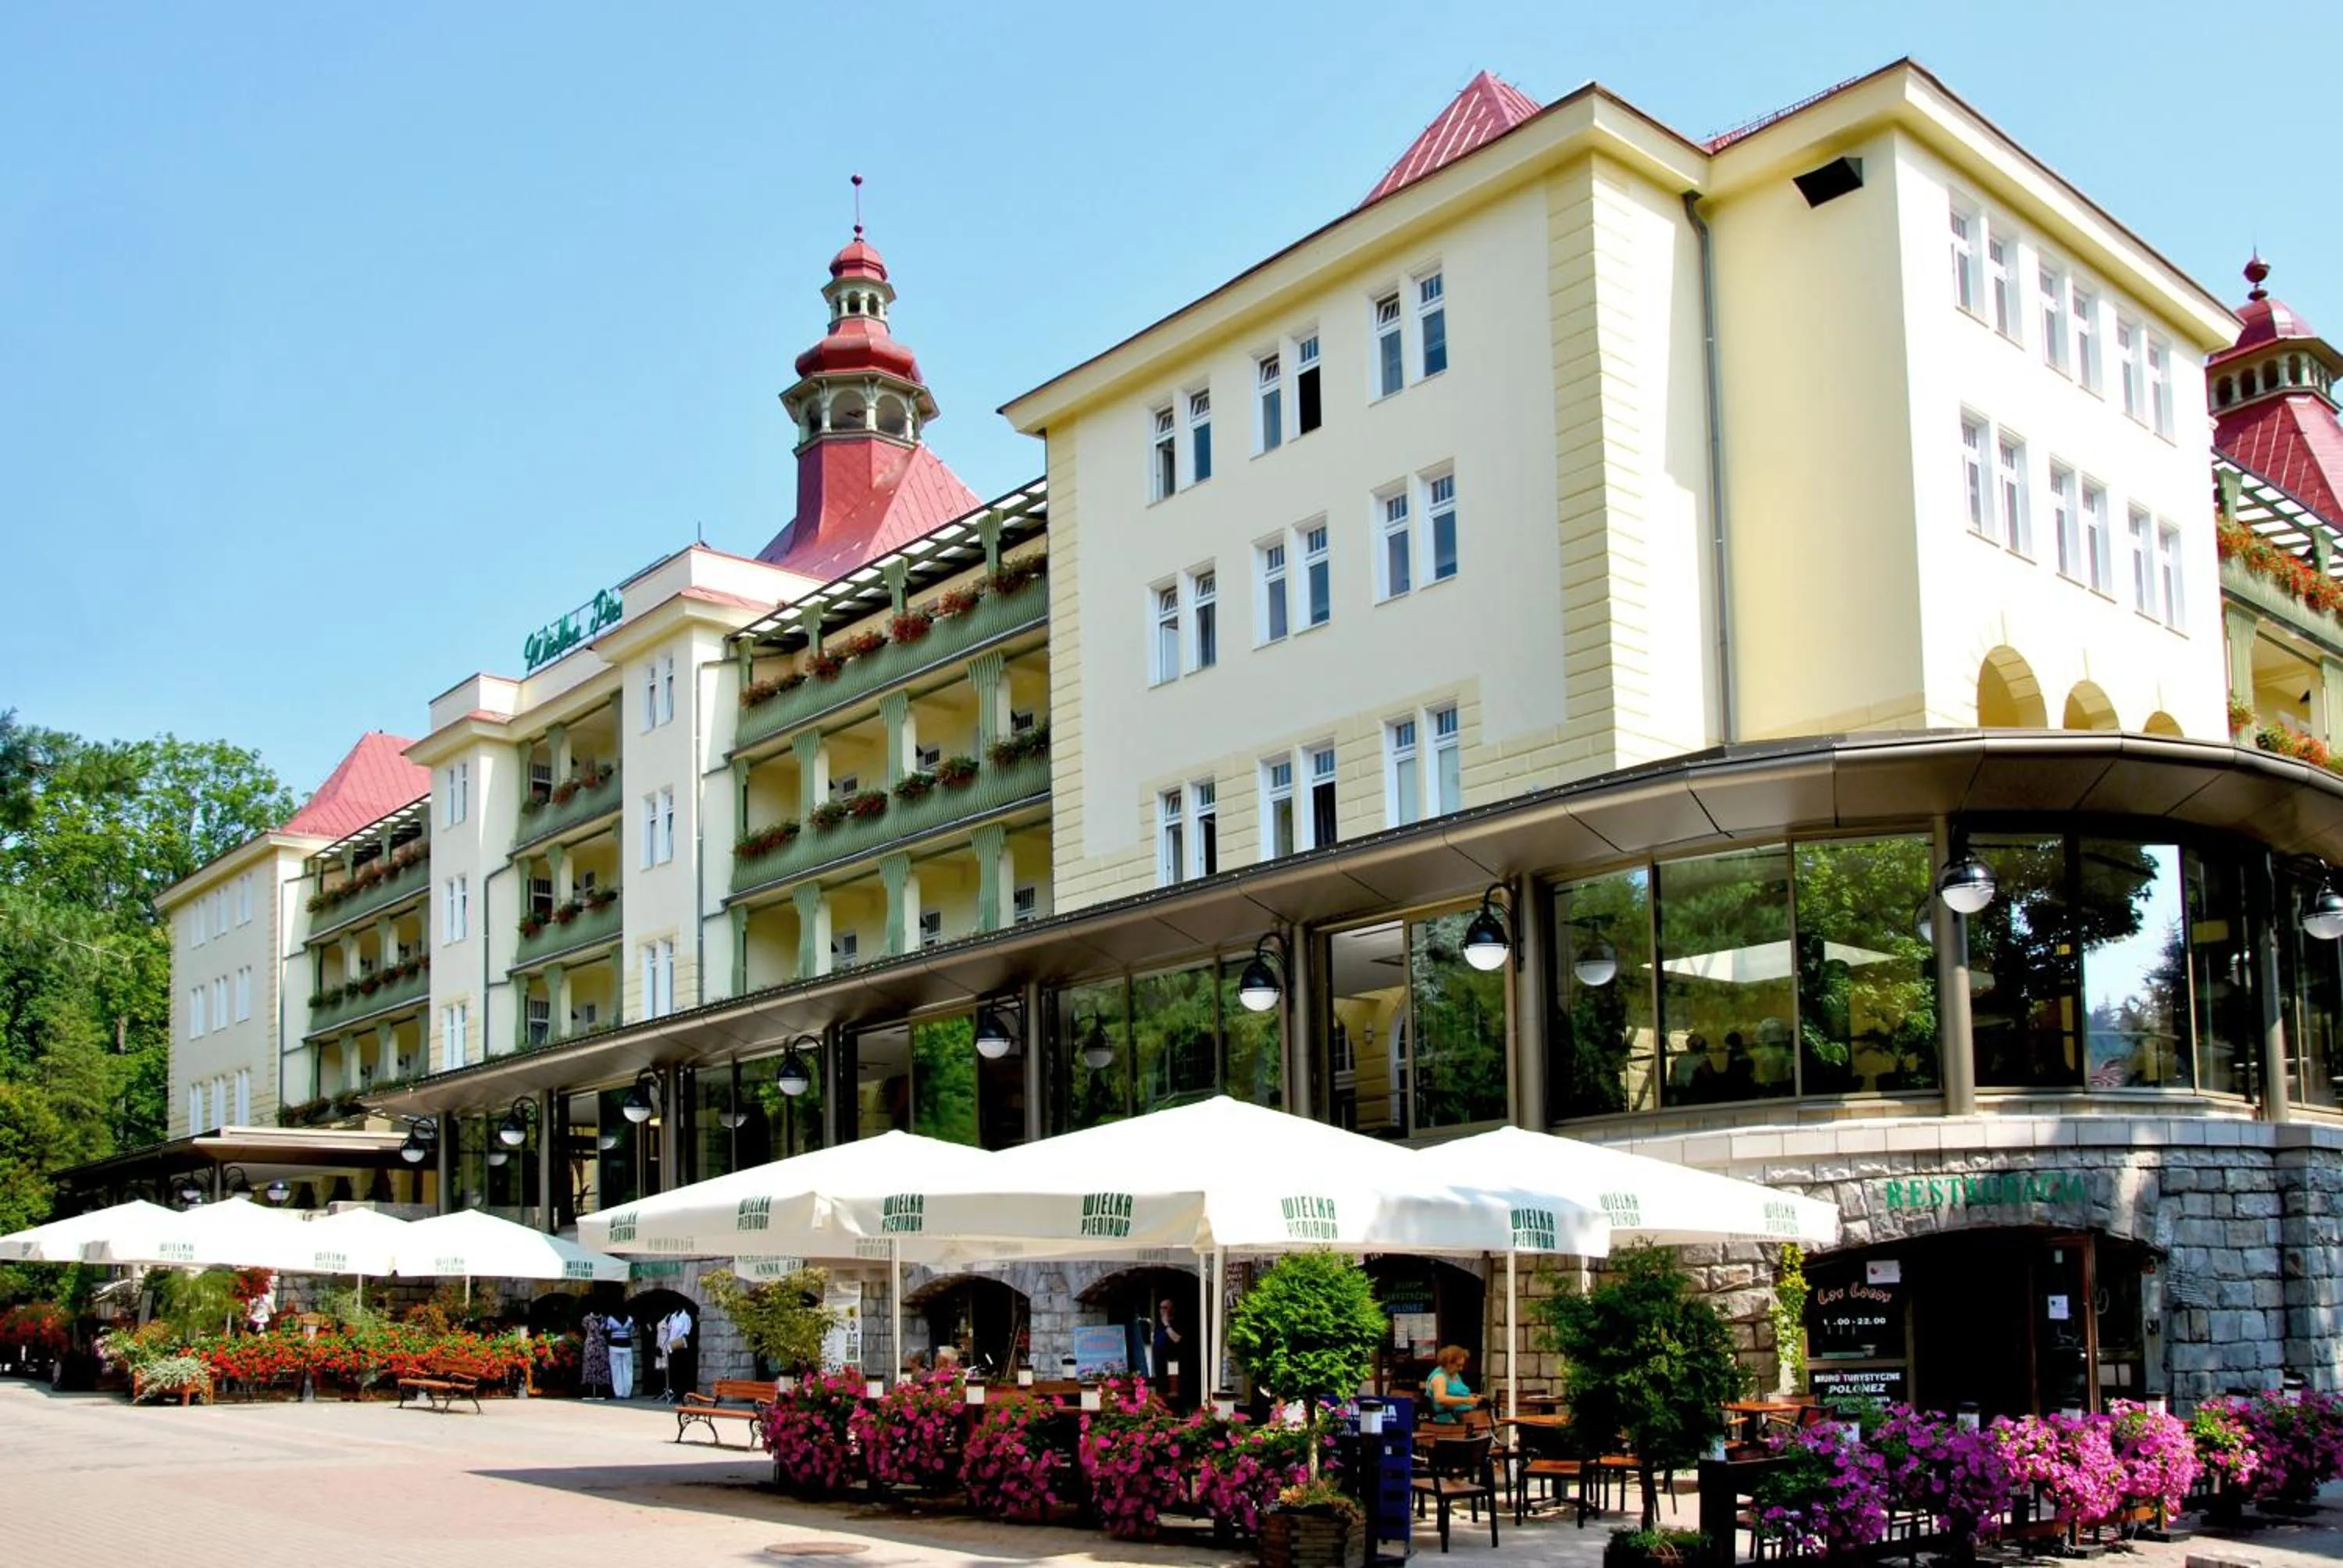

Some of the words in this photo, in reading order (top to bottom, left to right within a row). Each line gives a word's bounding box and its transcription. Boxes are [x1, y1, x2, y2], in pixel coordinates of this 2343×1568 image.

[1886, 1173, 2084, 1208] RESTAURACJA
[738, 1196, 772, 1215] WIELKA
[883, 1193, 924, 1216] WIELKA
[1083, 1193, 1133, 1218] WIELKA
[1281, 1196, 1336, 1220] WIELKA
[1081, 1217, 1131, 1238] PIENIAWA
[1511, 1209, 1554, 1231] WIELKA
[1844, 1372, 1900, 1382] TURYSTYCZNE
[1828, 1383, 1886, 1395] POLONEZ
